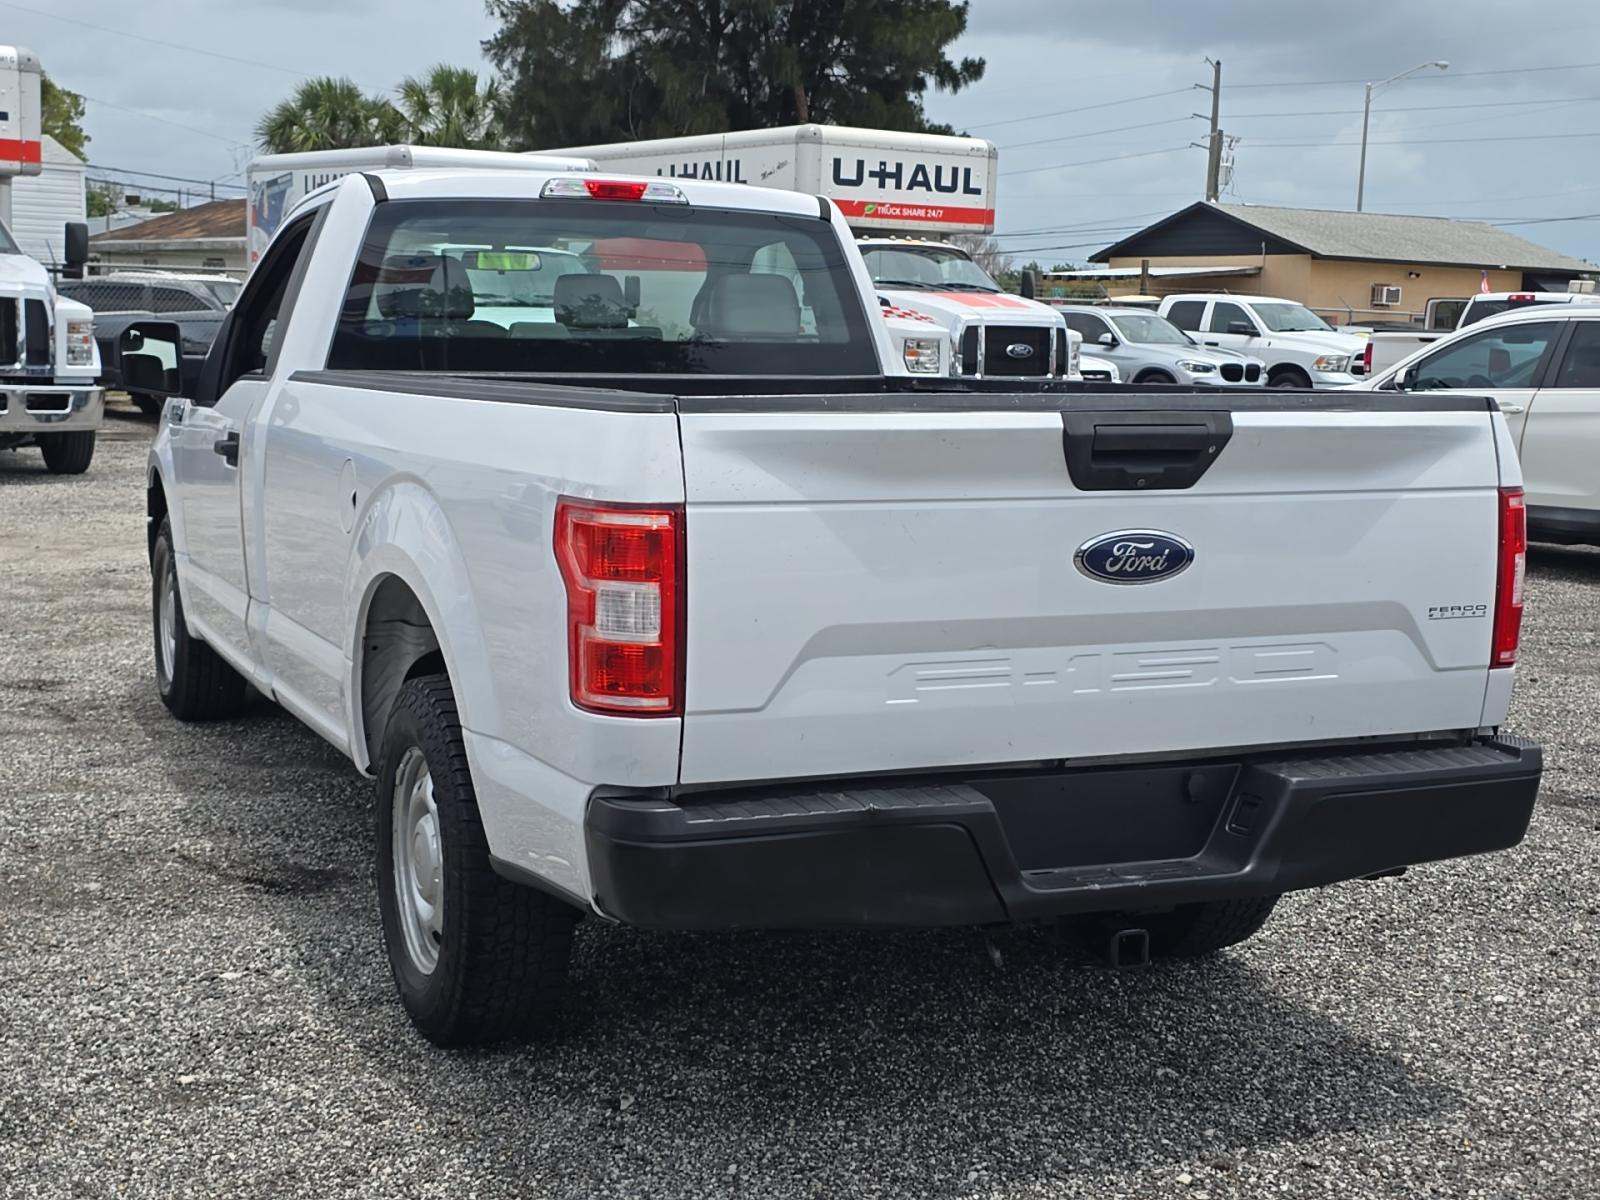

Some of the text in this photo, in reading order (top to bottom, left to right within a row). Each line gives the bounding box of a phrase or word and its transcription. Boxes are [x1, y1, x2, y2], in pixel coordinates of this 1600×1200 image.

[832, 157, 982, 196] U-HAUL
[877, 205, 944, 218] TRUCK SHARE 24/7
[1105, 541, 1171, 573] Ford
